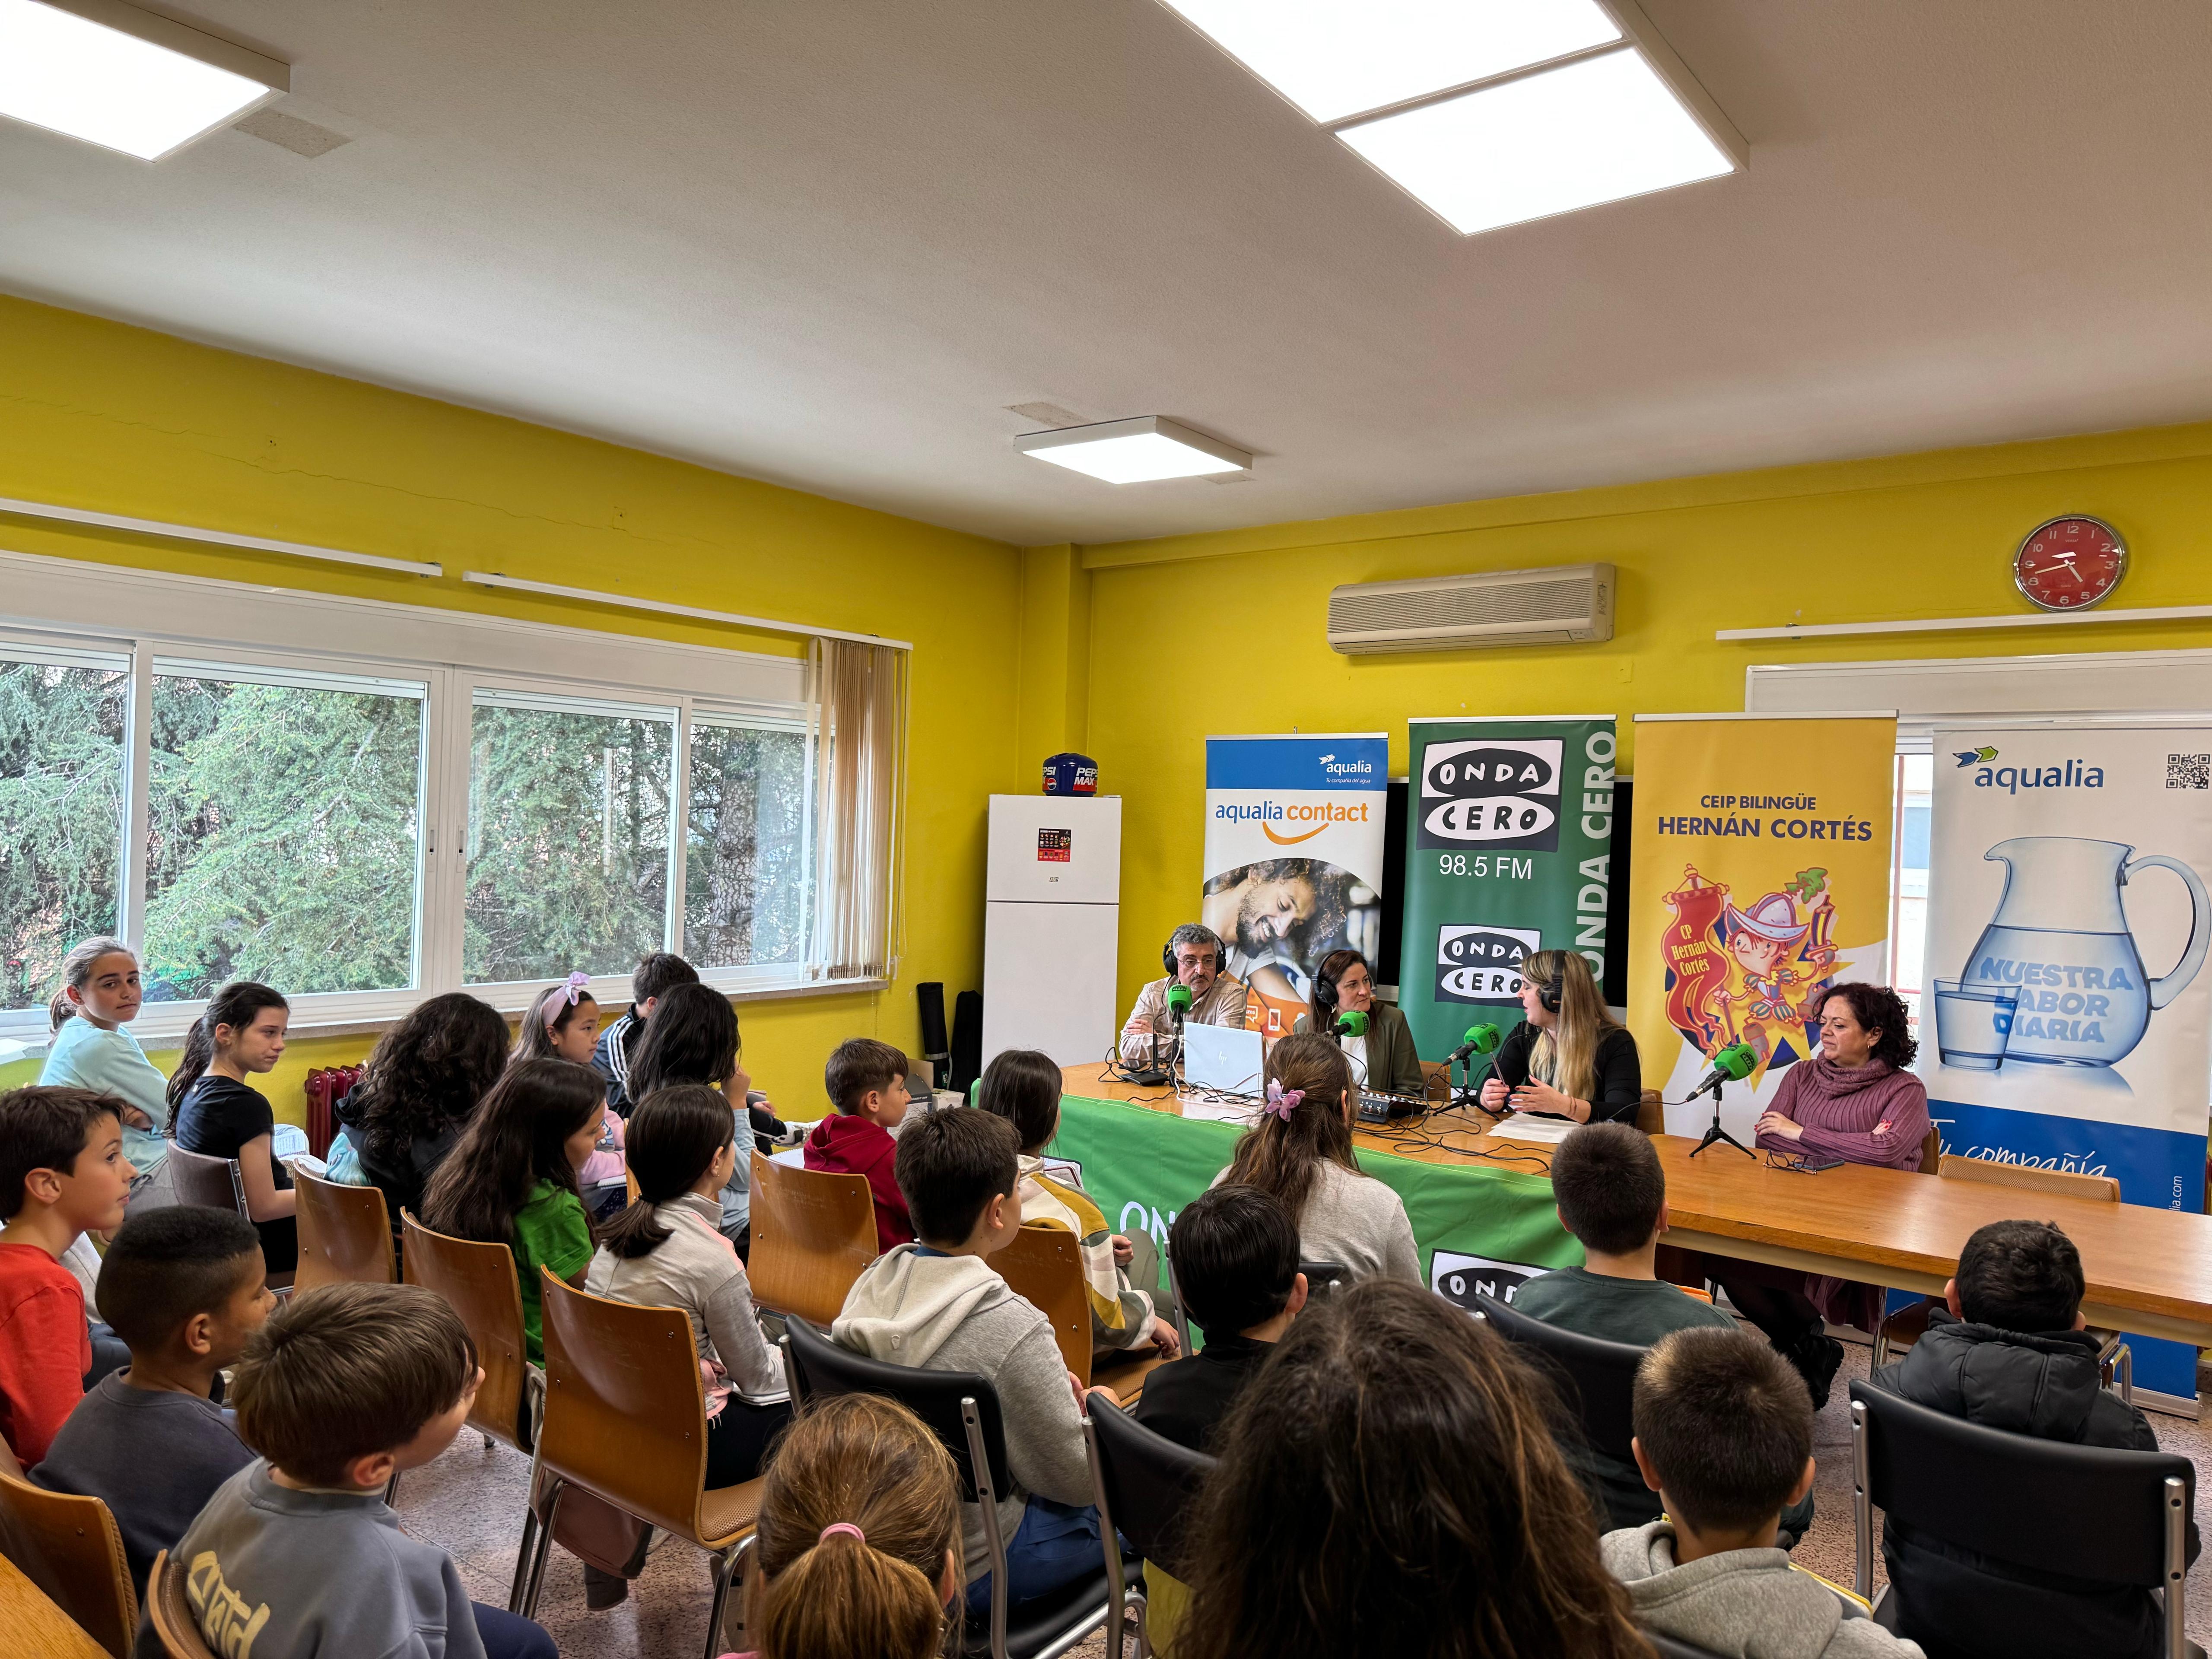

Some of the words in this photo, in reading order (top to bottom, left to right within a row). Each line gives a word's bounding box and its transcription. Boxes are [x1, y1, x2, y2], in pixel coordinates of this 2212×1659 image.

[2049, 531, 2056, 539] 11
[2067, 525, 2079, 534] 12
[2091, 530, 2095, 538] 1
[2033, 543, 2043, 552] 10
[2101, 543, 2111, 552] 2
[2024, 560, 2034, 569] 9
[2104, 561, 2114, 569] 3
[2028, 578, 2039, 586] 8
[2096, 578, 2106, 587] 4
[2041, 591, 2051, 599] 7
[2059, 596, 2069, 604] 6
[1042, 766, 1056, 775] PSI
[1076, 767, 1098, 777] PEPS
[1326, 760, 1372, 776] aqualia
[1439, 762, 1539, 785] ONDA
[1974, 759, 2104, 795] aqualia
[1074, 777, 1095, 785] MAX
[1581, 731, 1616, 839] CERO
[1700, 795, 1736, 809] CEIP
[1740, 793, 1816, 810] BILINGÜE
[1215, 800, 1283, 824] aqualia
[1286, 802, 1369, 823] contact
[1442, 805, 1538, 831] CERO
[1658, 812, 1761, 837] HERNÁN
[1771, 815, 1872, 842] CORTÉS
[1439, 854, 1488, 877] 98.5
[1496, 857, 1533, 880] FM
[1575, 854, 1611, 982] ONDA
[1680, 924, 1693, 940] CP
[1452, 940, 1524, 960] ONDA
[1670, 940, 1708, 960] Hernán
[1679, 956, 1710, 976] Cortés
[1980, 957, 2134, 990] NUESTRA
[1453, 970, 1522, 994] CERO
[1994, 987, 2110, 1017] LABOR
[1993, 1012, 2105, 1043] DIARIA
[1964, 1146, 2107, 1177] compañía
[1120, 1201, 1176, 1246] ON
[1450, 1275, 1518, 1303] ON
